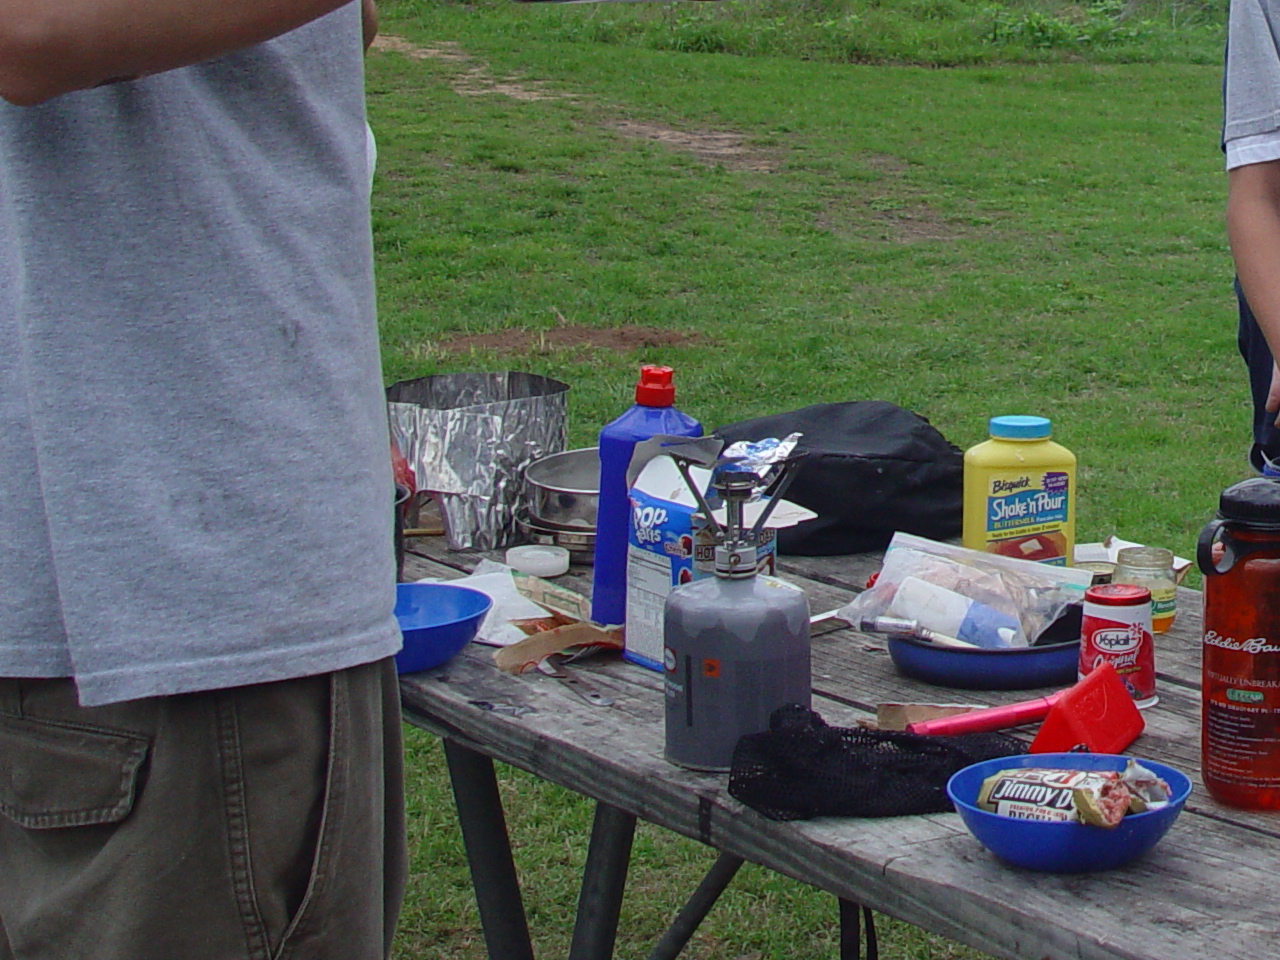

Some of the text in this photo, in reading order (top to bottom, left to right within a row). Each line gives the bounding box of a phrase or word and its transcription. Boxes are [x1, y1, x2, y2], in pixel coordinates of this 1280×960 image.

[992, 476, 1031, 495] Bisquick
[991, 497, 1028, 521] Shake
[1034, 492, 1066, 512] Pour
[1099, 633, 1131, 650] Yoplait
[1204, 630, 1243, 651] Eddie
[993, 779, 1077, 809] Jimmy D
